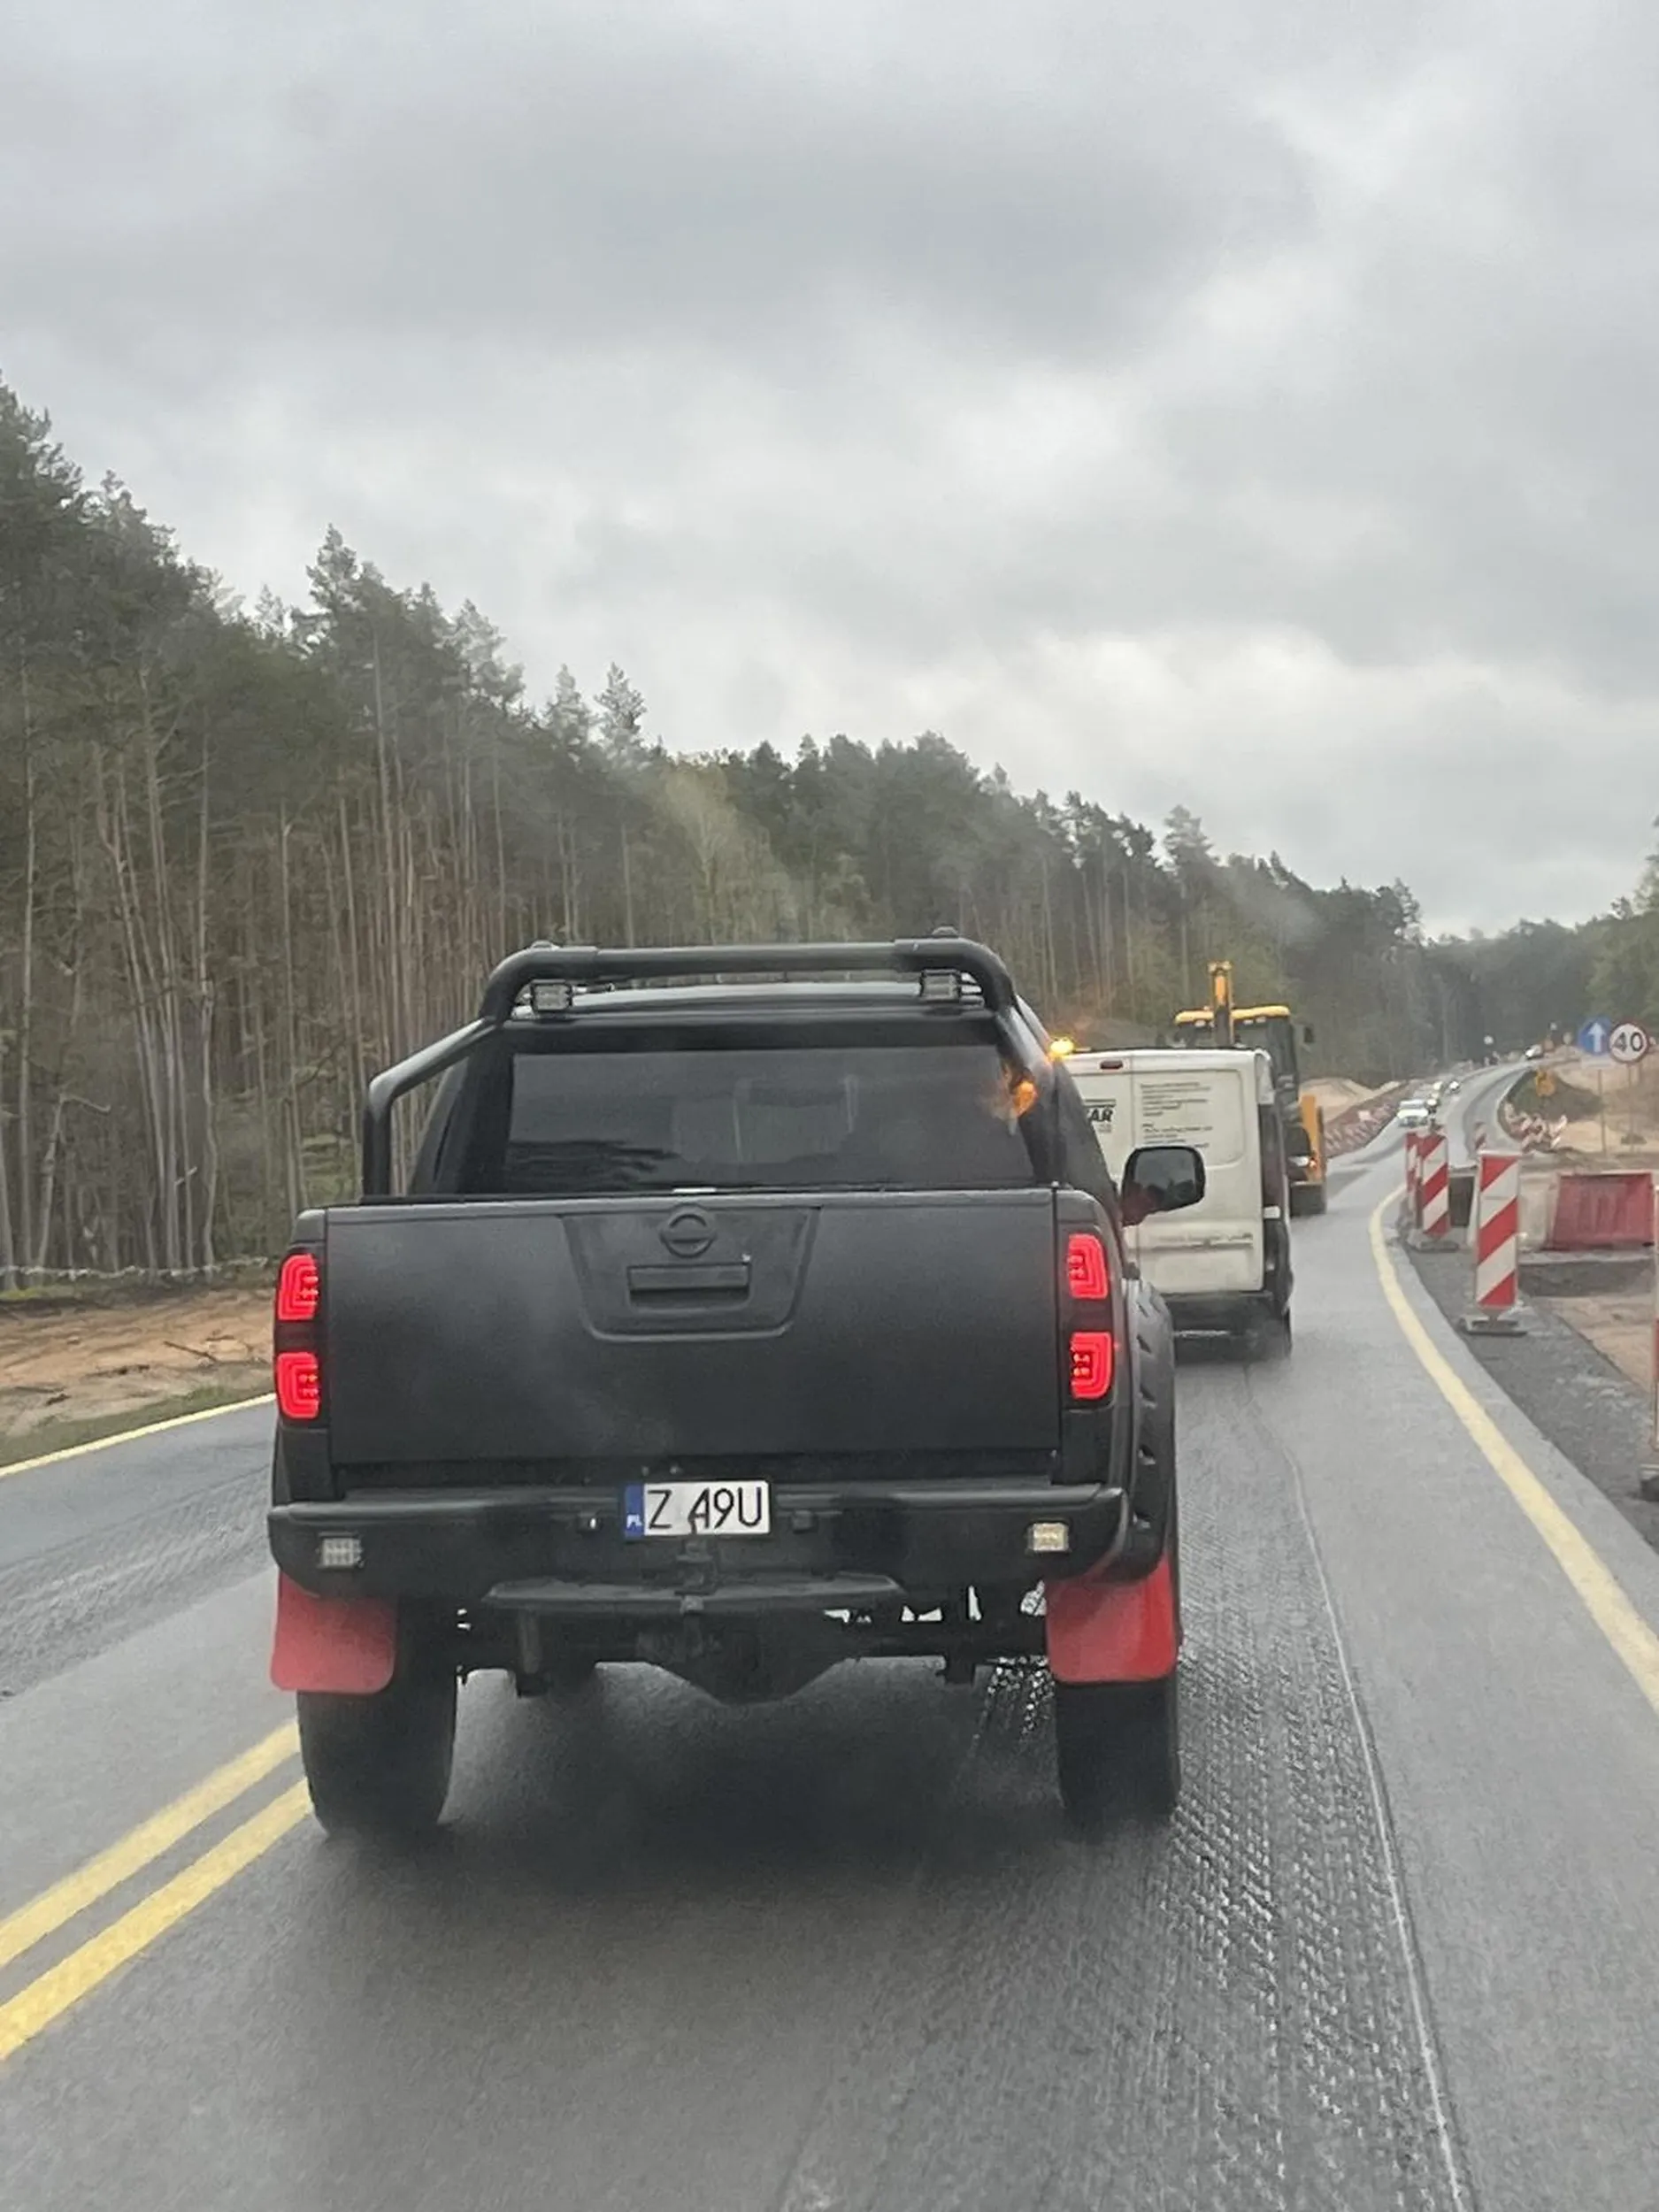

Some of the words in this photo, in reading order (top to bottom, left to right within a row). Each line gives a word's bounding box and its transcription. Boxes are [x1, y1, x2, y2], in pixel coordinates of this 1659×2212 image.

[1613, 1032, 1643, 1052] 40
[1087, 1108, 1113, 1122] AR
[647, 1489, 672, 1530] Z
[687, 1486, 762, 1530] A9U
